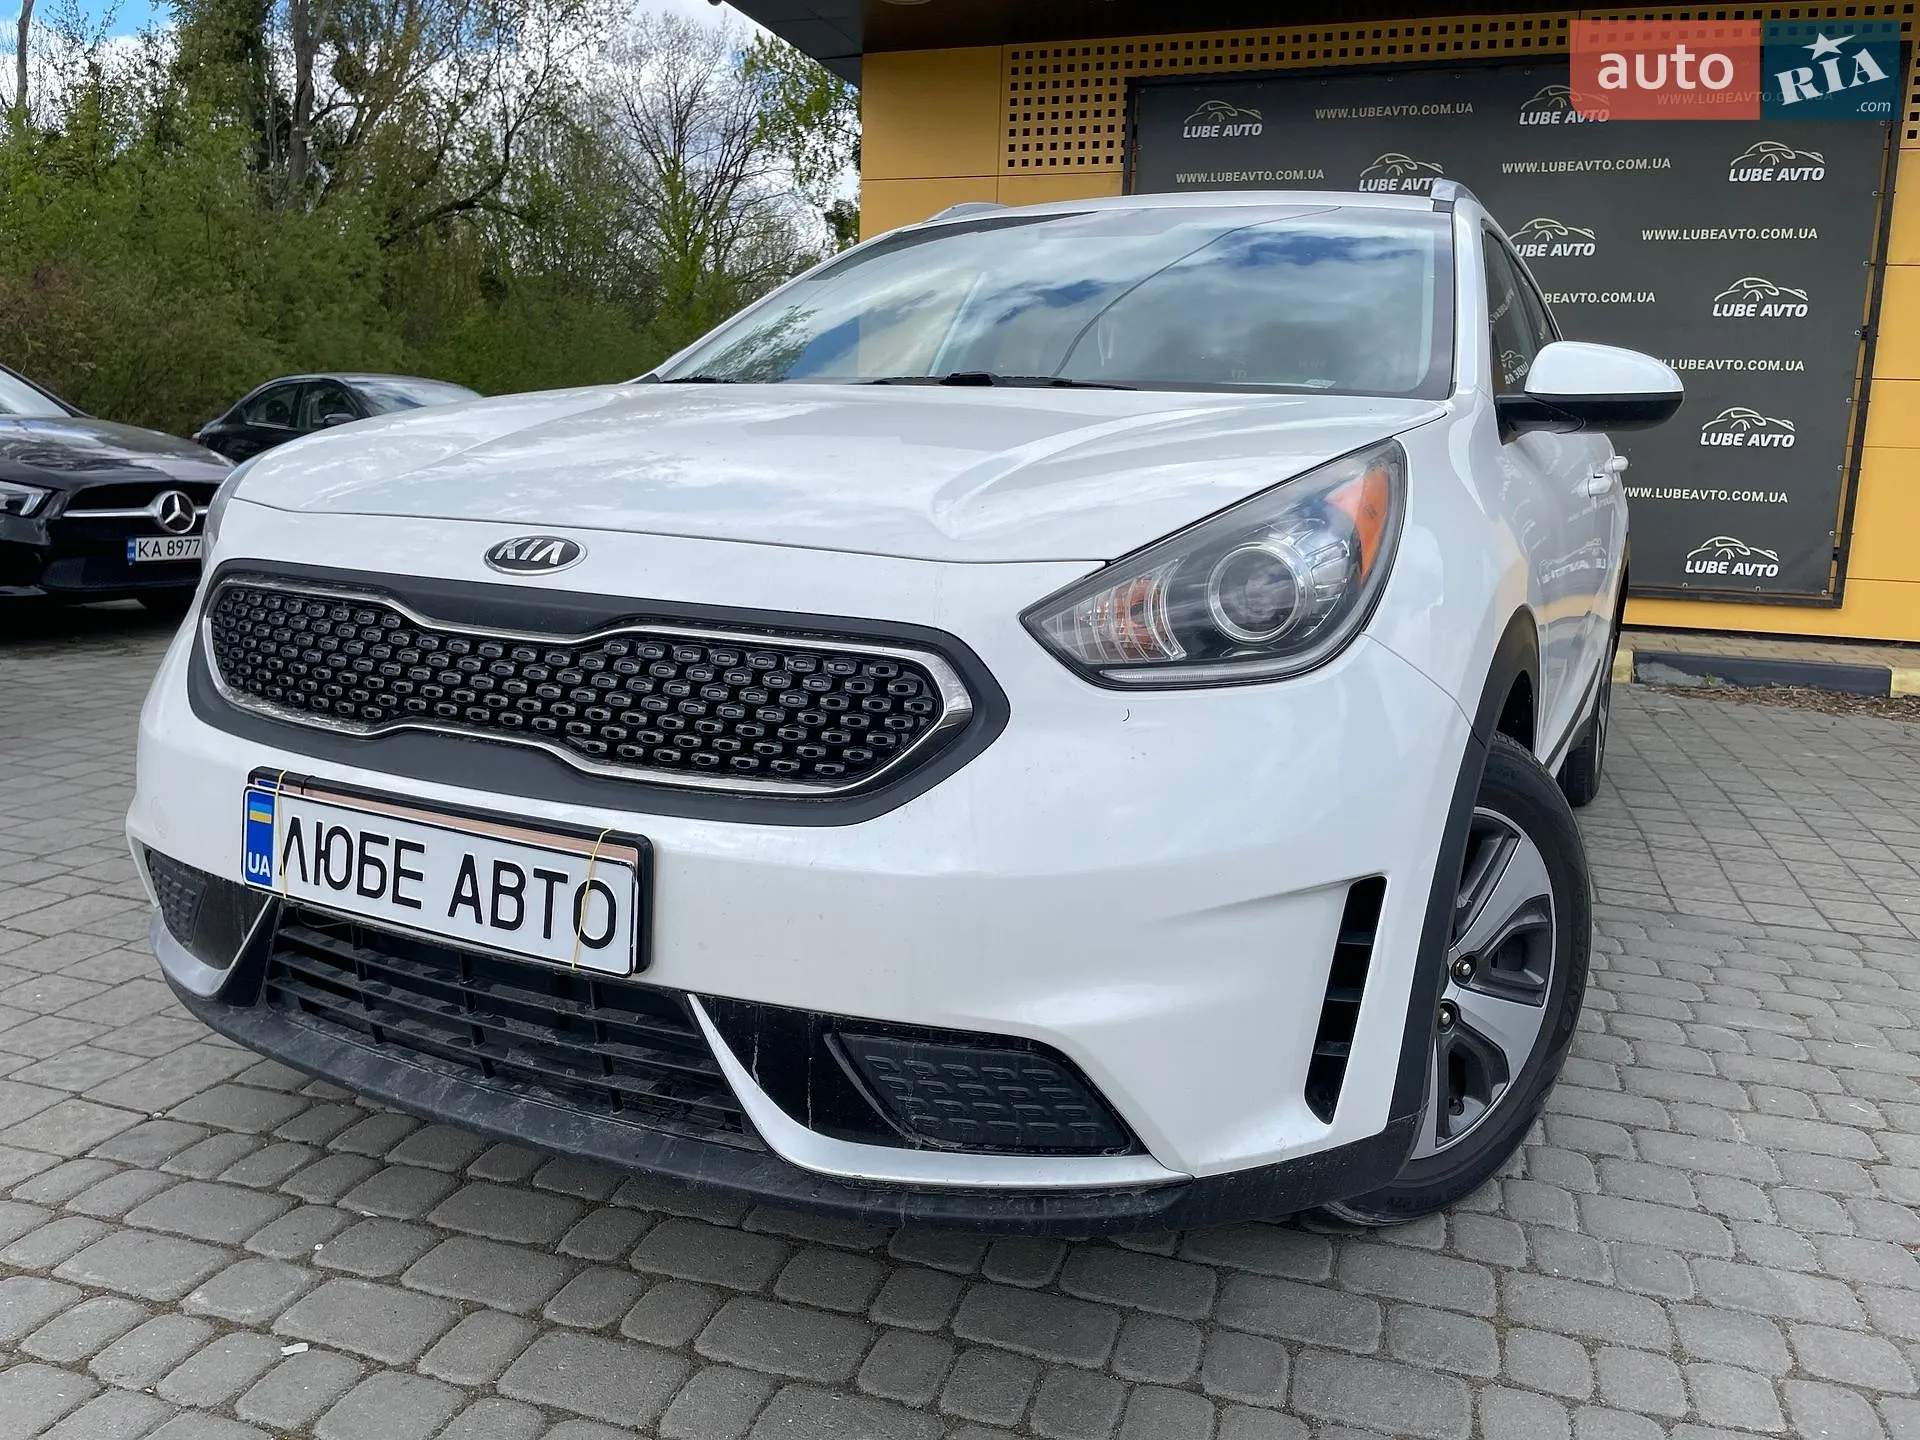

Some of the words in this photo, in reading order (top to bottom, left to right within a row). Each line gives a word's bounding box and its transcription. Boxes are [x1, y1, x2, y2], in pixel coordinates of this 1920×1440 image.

[1315, 103, 1474, 120] WWW.LUBEAVTO.COM.UA
[1519, 111, 1561, 125] LUBE
[1564, 109, 1610, 124] AVTO
[1183, 125, 1220, 138] LUBE
[1222, 123, 1263, 137] AVTO
[1503, 158, 1671, 174] WWW.LUBEAVTO.COM.UA
[1176, 169, 1325, 184] WWW.LUBEAVTO.COM.UA
[1728, 168, 1774, 182] LUBE
[1776, 167, 1825, 181] AVTO
[1358, 178, 1399, 191] LUBE
[1400, 177, 1434, 190] AVT
[1642, 227, 1818, 240] WWW.LUBEAVTO.COM.UA
[1515, 243, 1548, 257] UBE
[1550, 242, 1596, 256] AVTO
[1544, 292, 1656, 304] BEAVTO.COM.UA
[1712, 303, 1758, 317] LUBE
[1760, 303, 1809, 317] AVTO
[1660, 358, 1805, 372] LUBEAVTO.COM.UA
[1700, 432, 1745, 446] LUBE
[1747, 433, 1795, 448] AVTO
[138, 540, 162, 558] KA
[167, 539, 201, 557] 8977
[494, 538, 566, 566] KIA
[1685, 560, 1730, 574] LUBE
[1732, 562, 1779, 577] AVTO
[248, 850, 272, 878] UA
[279, 815, 426, 910] ЛЮБЕ
[447, 853, 617, 949] АВТО
